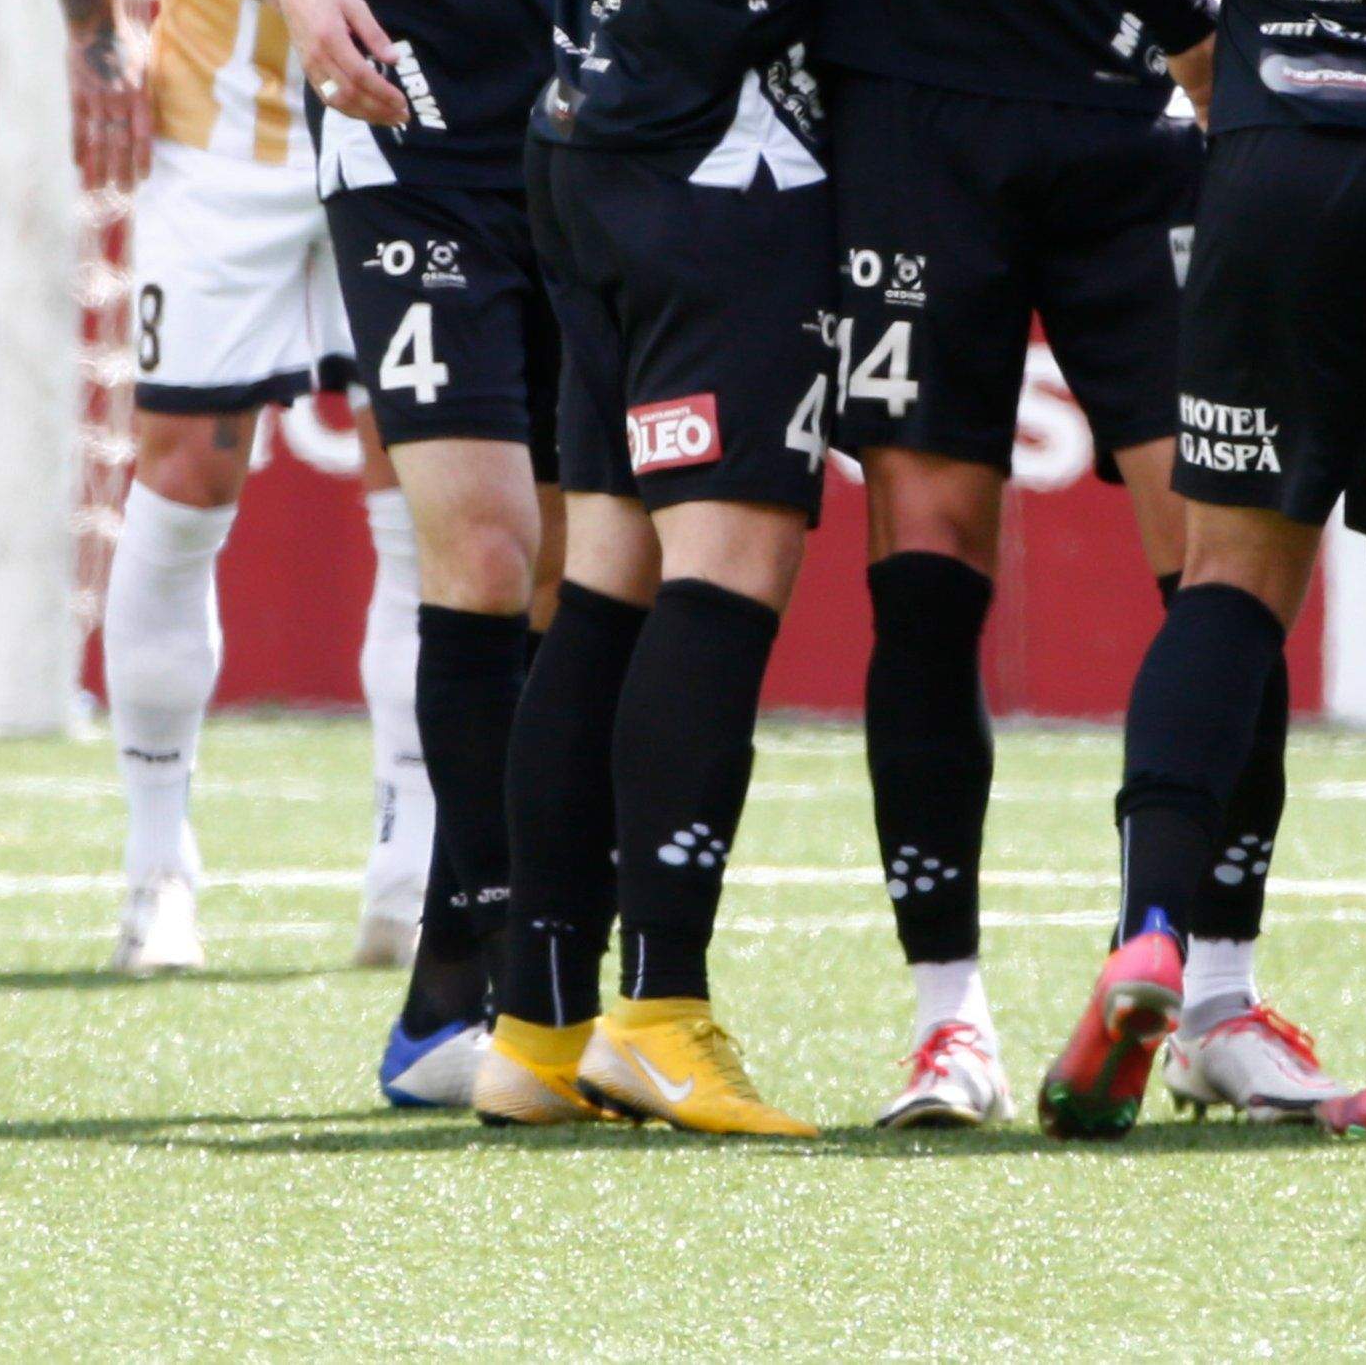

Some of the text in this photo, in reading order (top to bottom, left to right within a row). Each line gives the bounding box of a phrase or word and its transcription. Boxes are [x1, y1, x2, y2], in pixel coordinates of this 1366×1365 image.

[379, 301, 449, 404] 4
[837, 316, 919, 418] 14
[1179, 392, 1281, 437] HOTEL
[1180, 434, 1282, 474] GASPÀ
